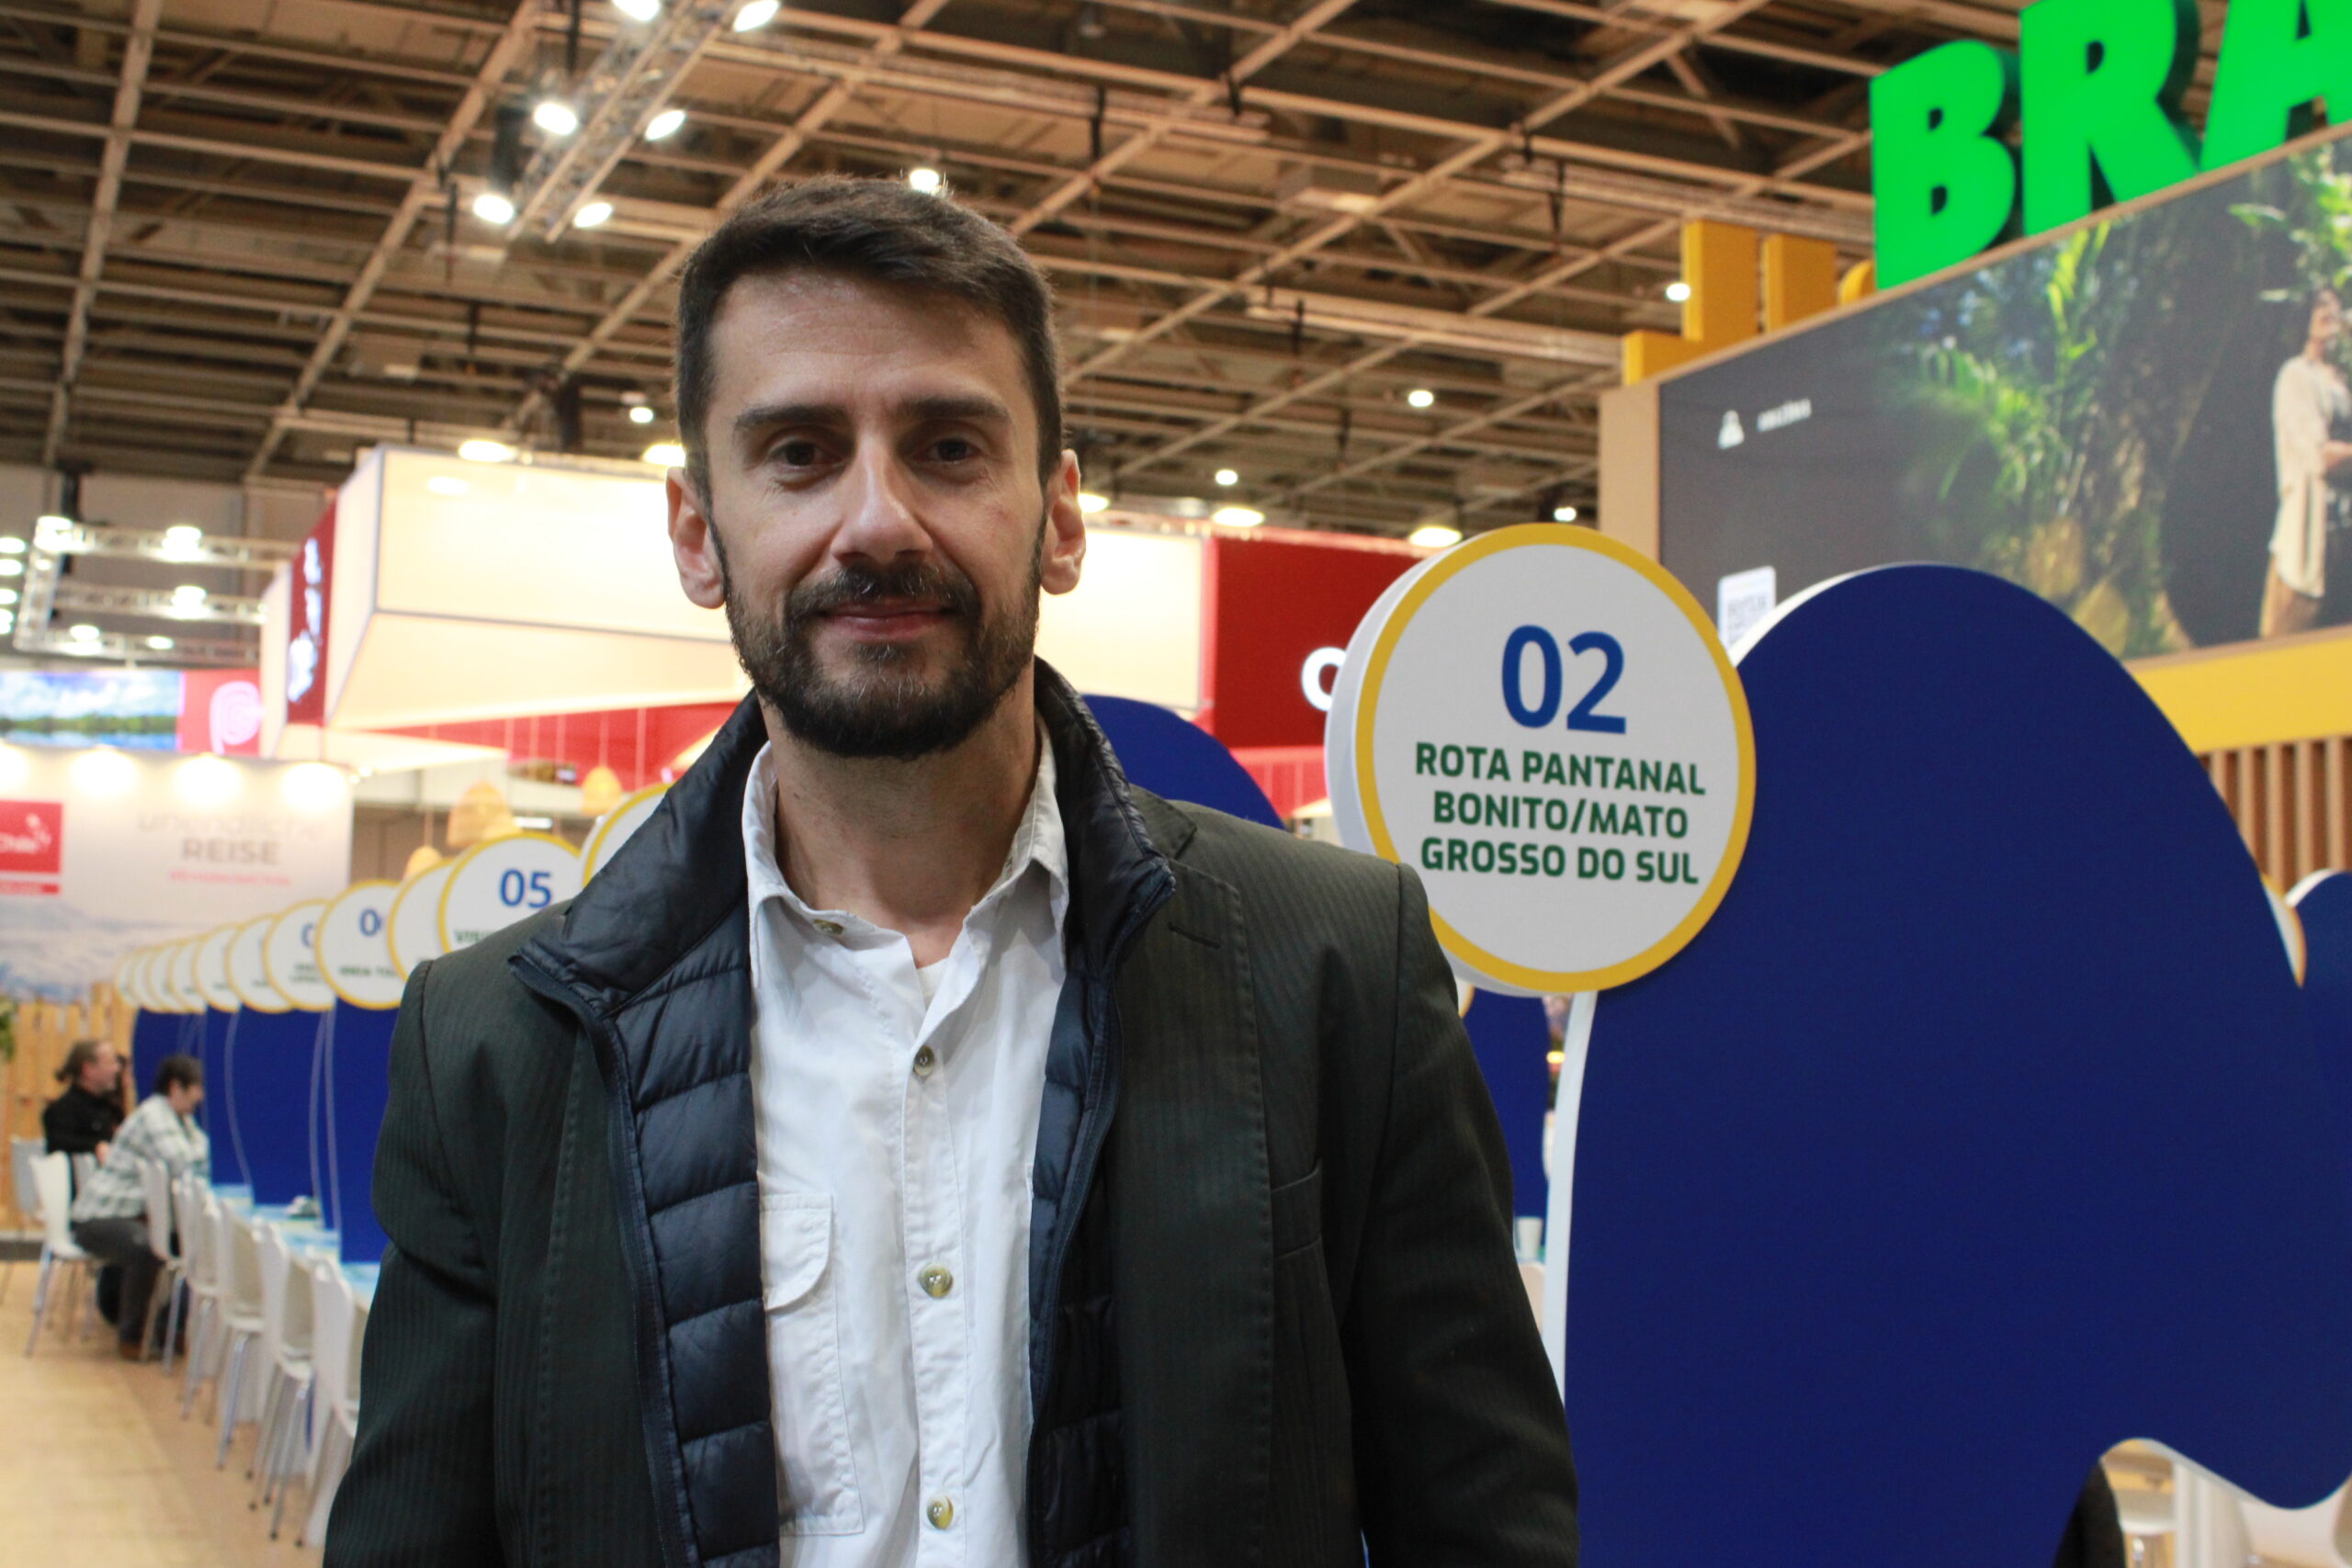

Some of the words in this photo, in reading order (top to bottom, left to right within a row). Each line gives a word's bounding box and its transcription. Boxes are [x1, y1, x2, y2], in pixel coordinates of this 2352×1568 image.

[1501, 625, 1627, 734] 02
[1416, 741, 1511, 782] ROTA
[1522, 750, 1706, 795] PANTANAL
[1433, 790, 1689, 839] BONITO/MATO
[182, 837, 281, 864] REISE
[1420, 837, 1566, 877] GROSSO
[1577, 847, 1625, 881] DO
[1636, 850, 1699, 885] SUL
[499, 868, 553, 909] 05
